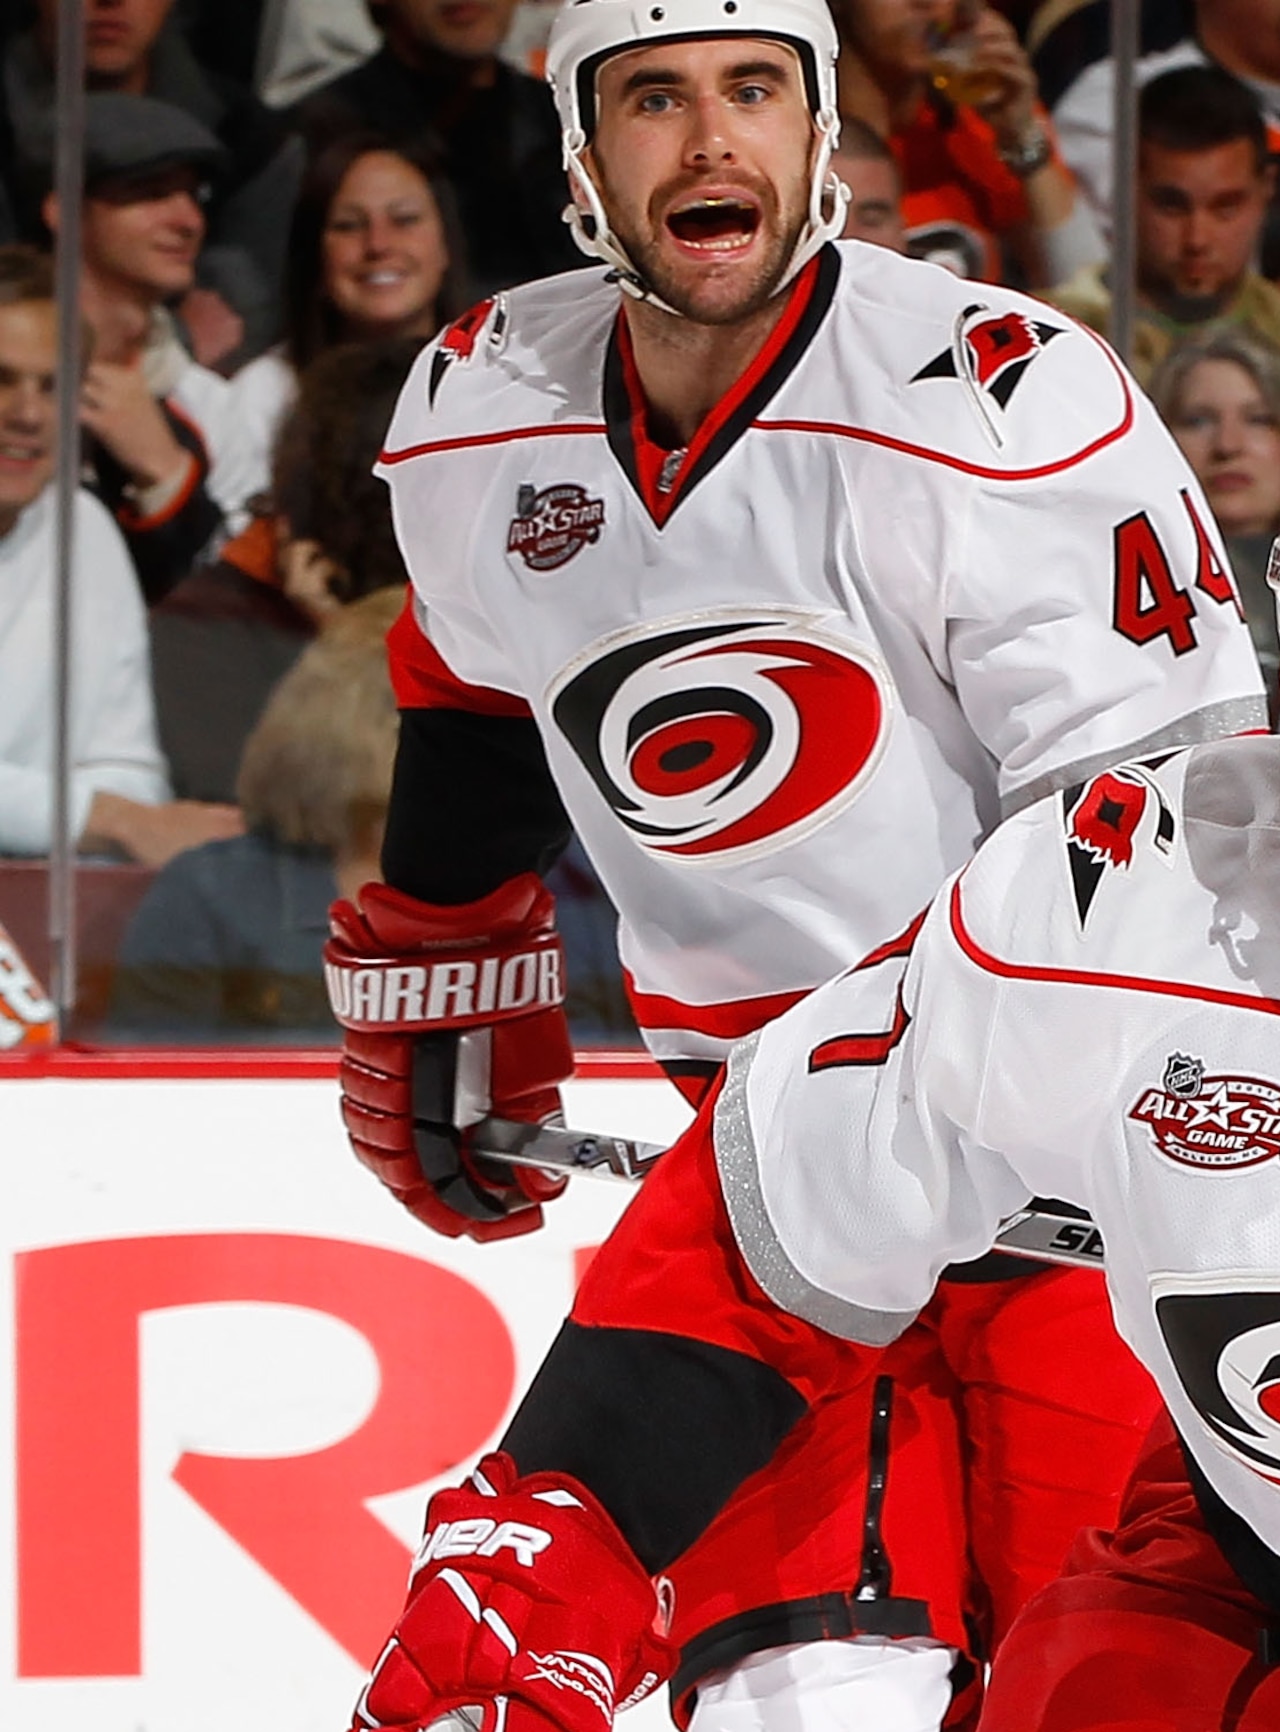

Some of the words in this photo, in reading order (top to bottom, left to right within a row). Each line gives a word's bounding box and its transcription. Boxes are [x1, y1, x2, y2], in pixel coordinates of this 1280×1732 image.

[324, 948, 566, 1022] WARRIOR
[1137, 1092, 1190, 1121] ALL
[1187, 1130, 1249, 1150] GAME
[15, 1233, 601, 1677] R
